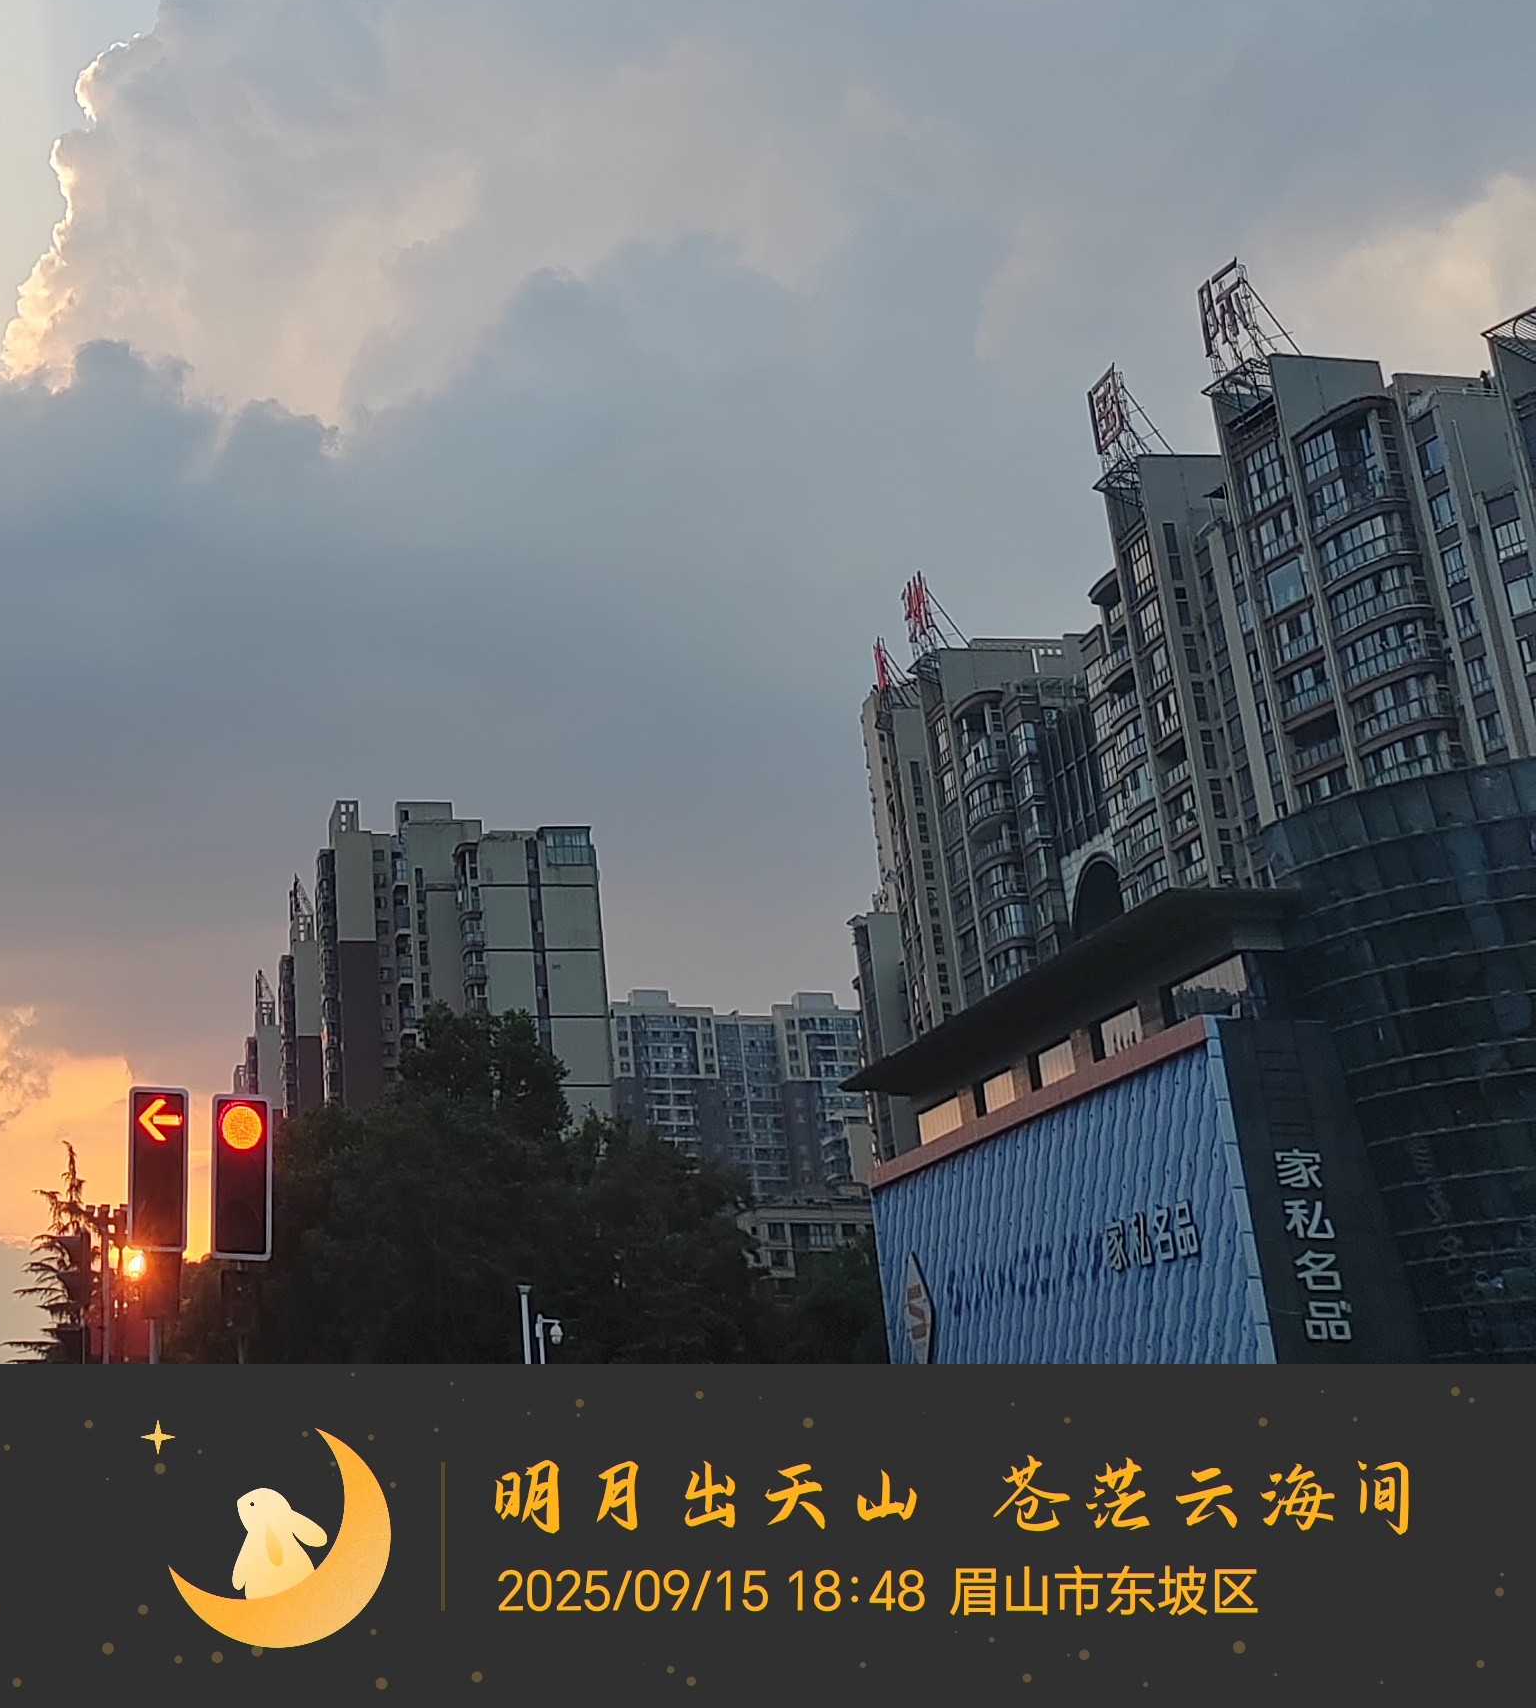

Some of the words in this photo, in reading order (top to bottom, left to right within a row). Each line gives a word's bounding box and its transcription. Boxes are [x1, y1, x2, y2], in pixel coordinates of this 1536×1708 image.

[1105, 1200, 1200, 1271] 家私名品
[1275, 1148, 1352, 1342] 家私名品
